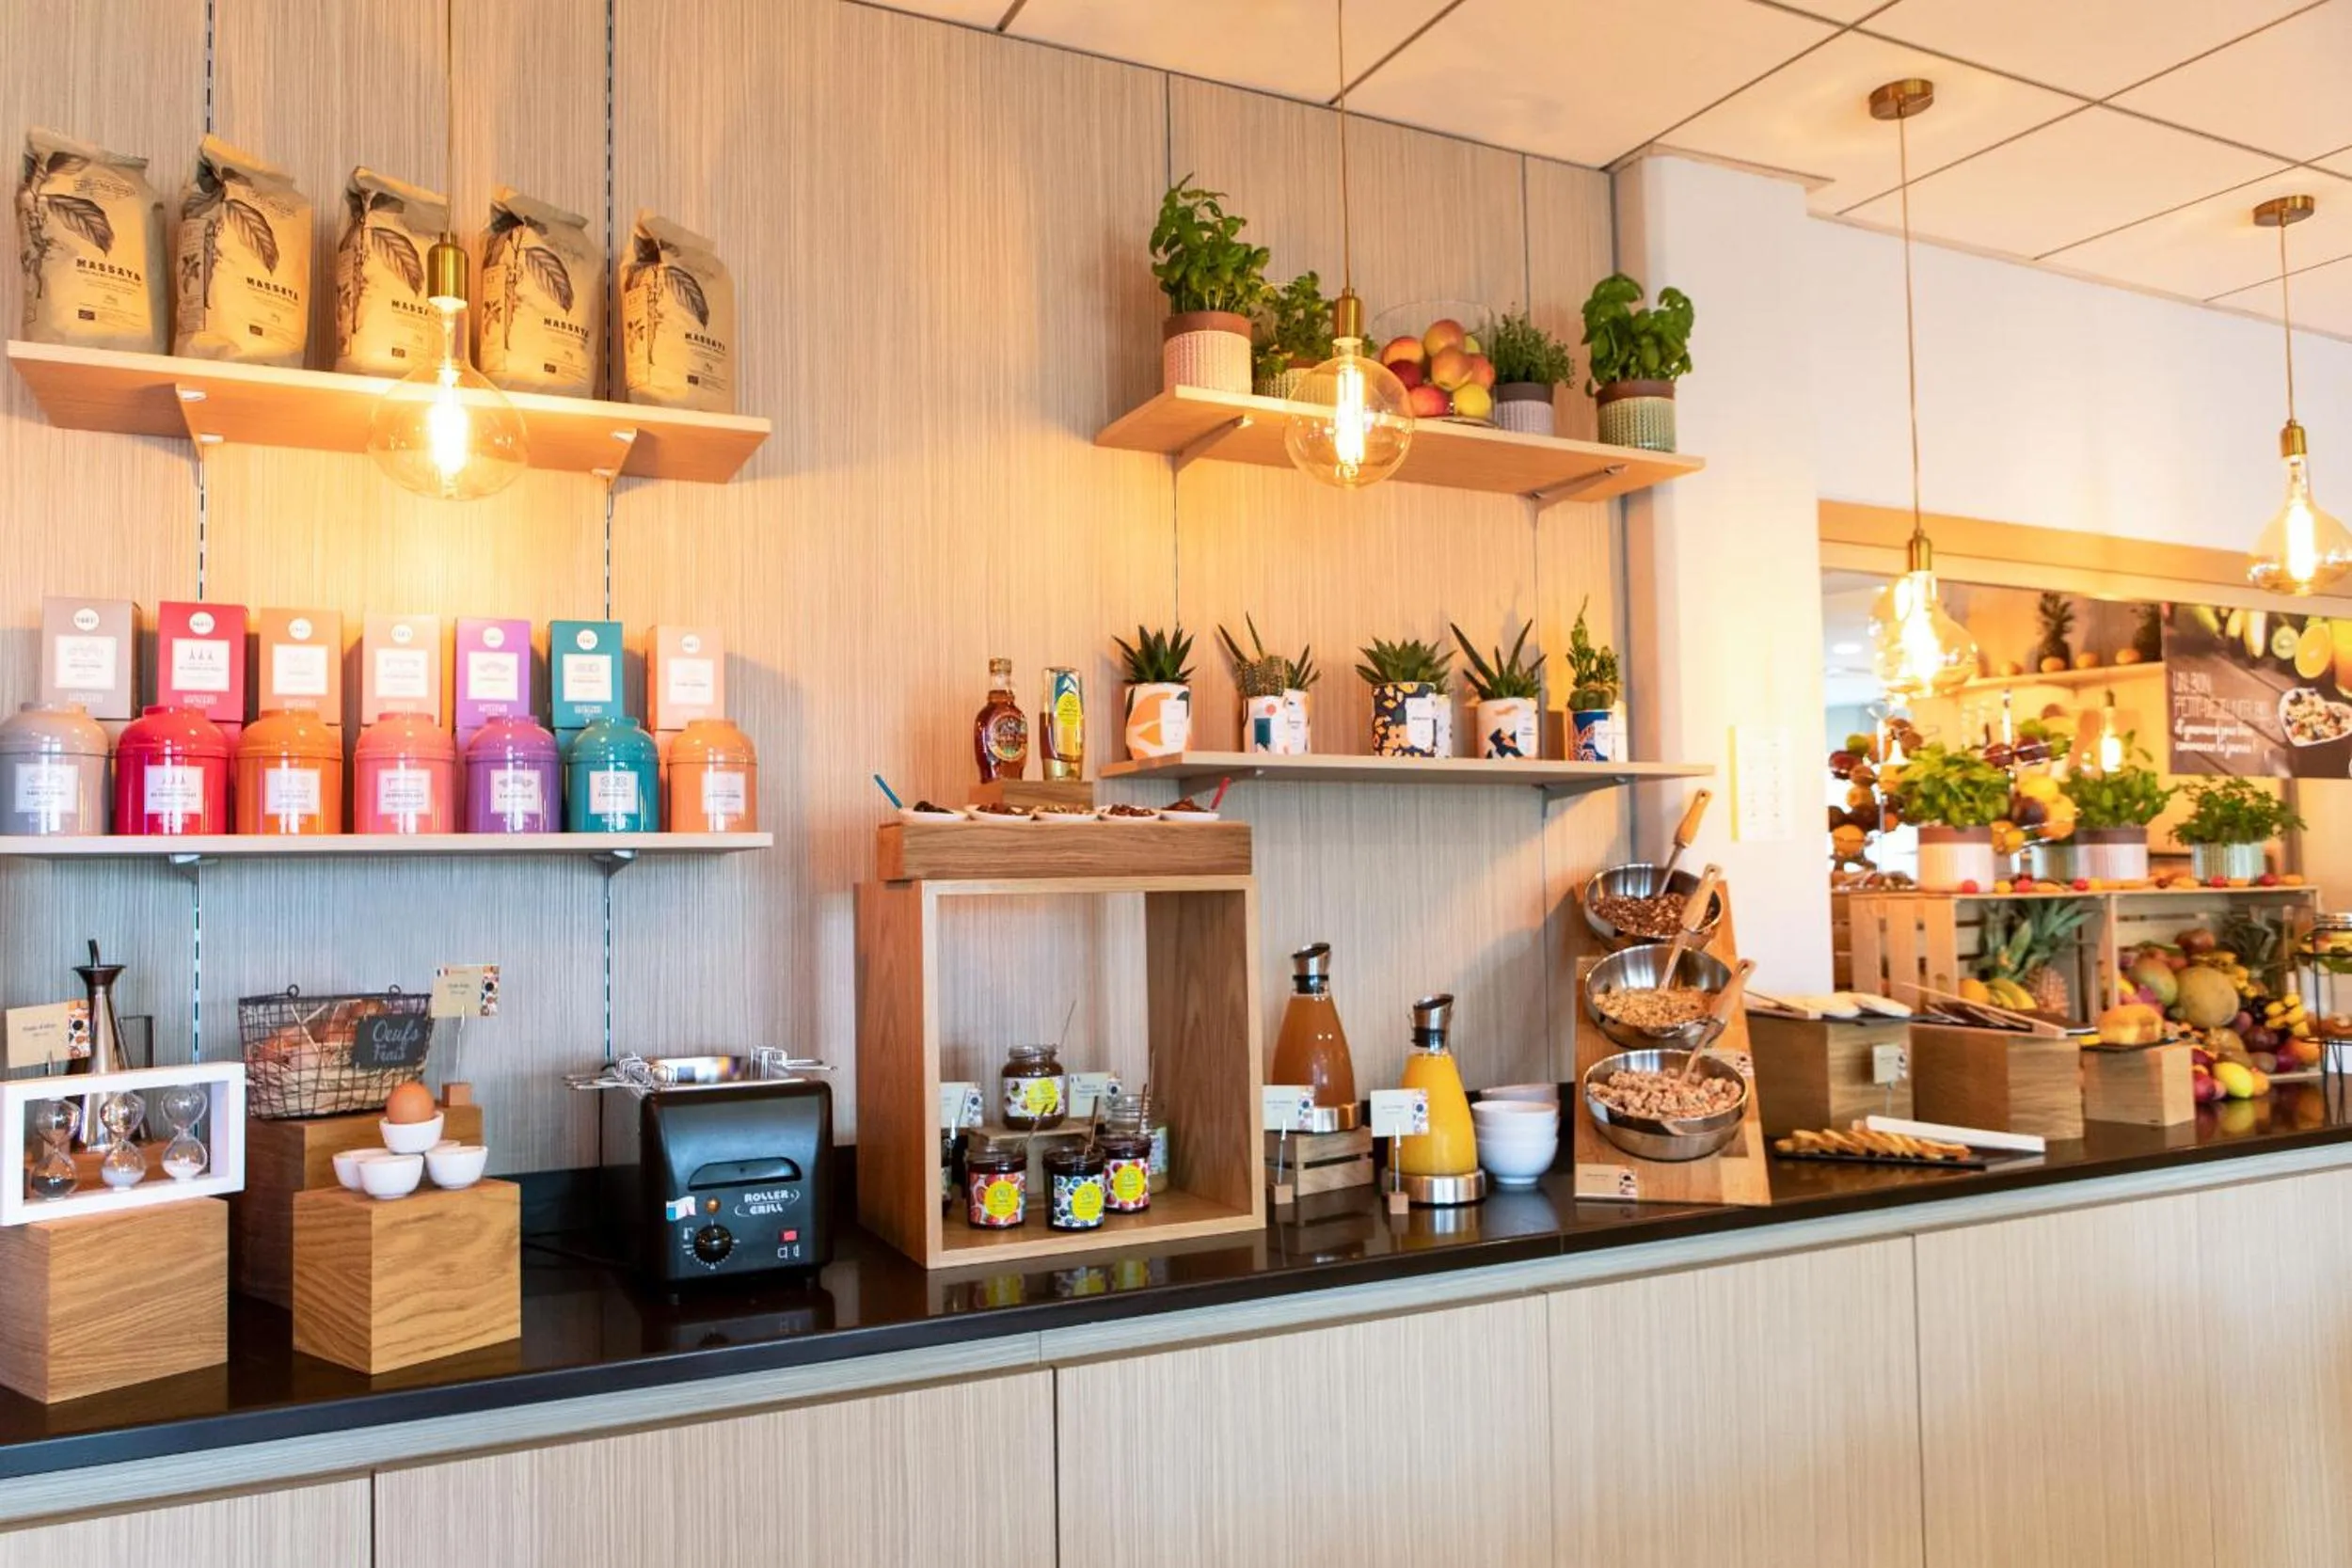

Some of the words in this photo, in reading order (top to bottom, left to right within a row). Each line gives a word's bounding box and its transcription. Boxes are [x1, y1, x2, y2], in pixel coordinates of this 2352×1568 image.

[76, 258, 141, 281] MASSAYA
[744, 1190, 789, 1203] ROLLER
[750, 1203, 784, 1215] GRILL
